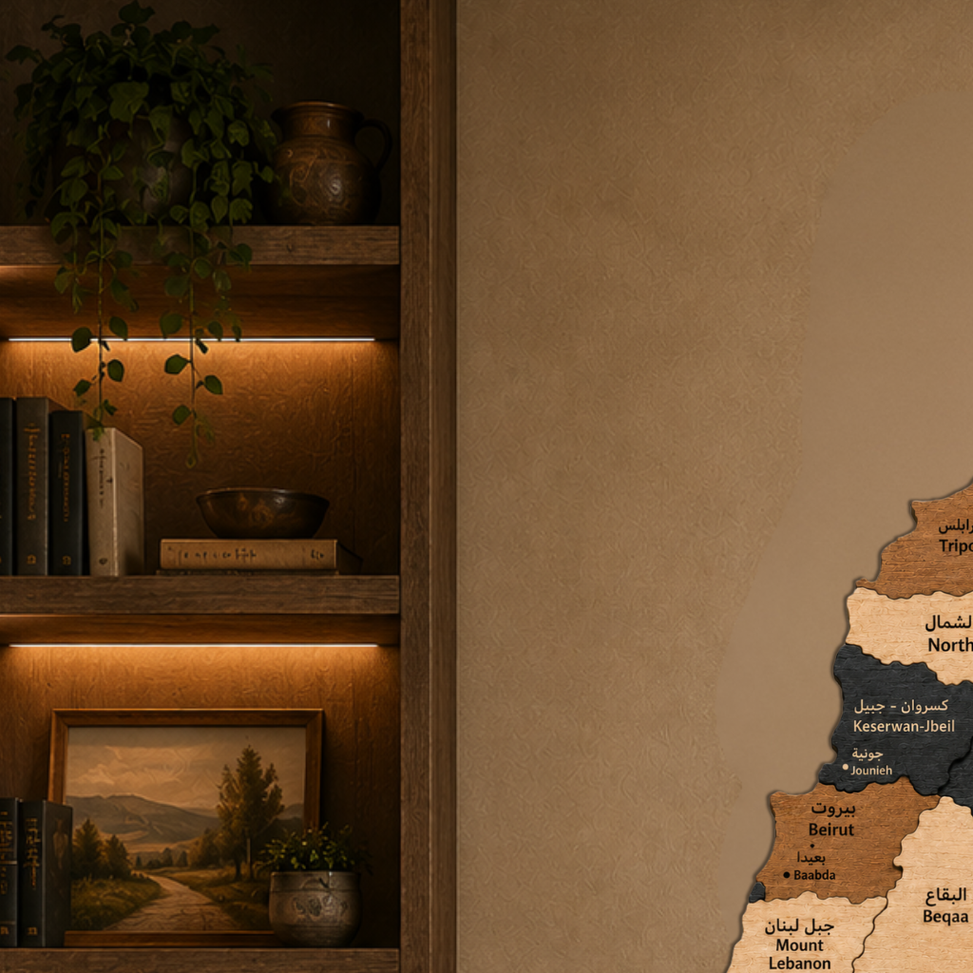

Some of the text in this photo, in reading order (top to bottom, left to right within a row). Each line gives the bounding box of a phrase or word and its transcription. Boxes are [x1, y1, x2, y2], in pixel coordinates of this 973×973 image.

[854, 698, 886, 715] جبيل
[901, 699, 949, 715] كسروان
[853, 719, 955, 733] Keserwan-Jbeil
[851, 747, 884, 762] جونية
[850, 765, 893, 776] Jounieh
[811, 802, 856, 819] بيروت
[808, 822, 855, 837] Beirut
[796, 851, 826, 866] بعيدا
[793, 868, 836, 881] Baabda
[925, 887, 967, 907] البقاع
[923, 909, 969, 927] Beqaa
[764, 918, 835, 936] جبل لبنان
[775, 938, 824, 952] Mount
[769, 956, 831, 970] Lebanon
